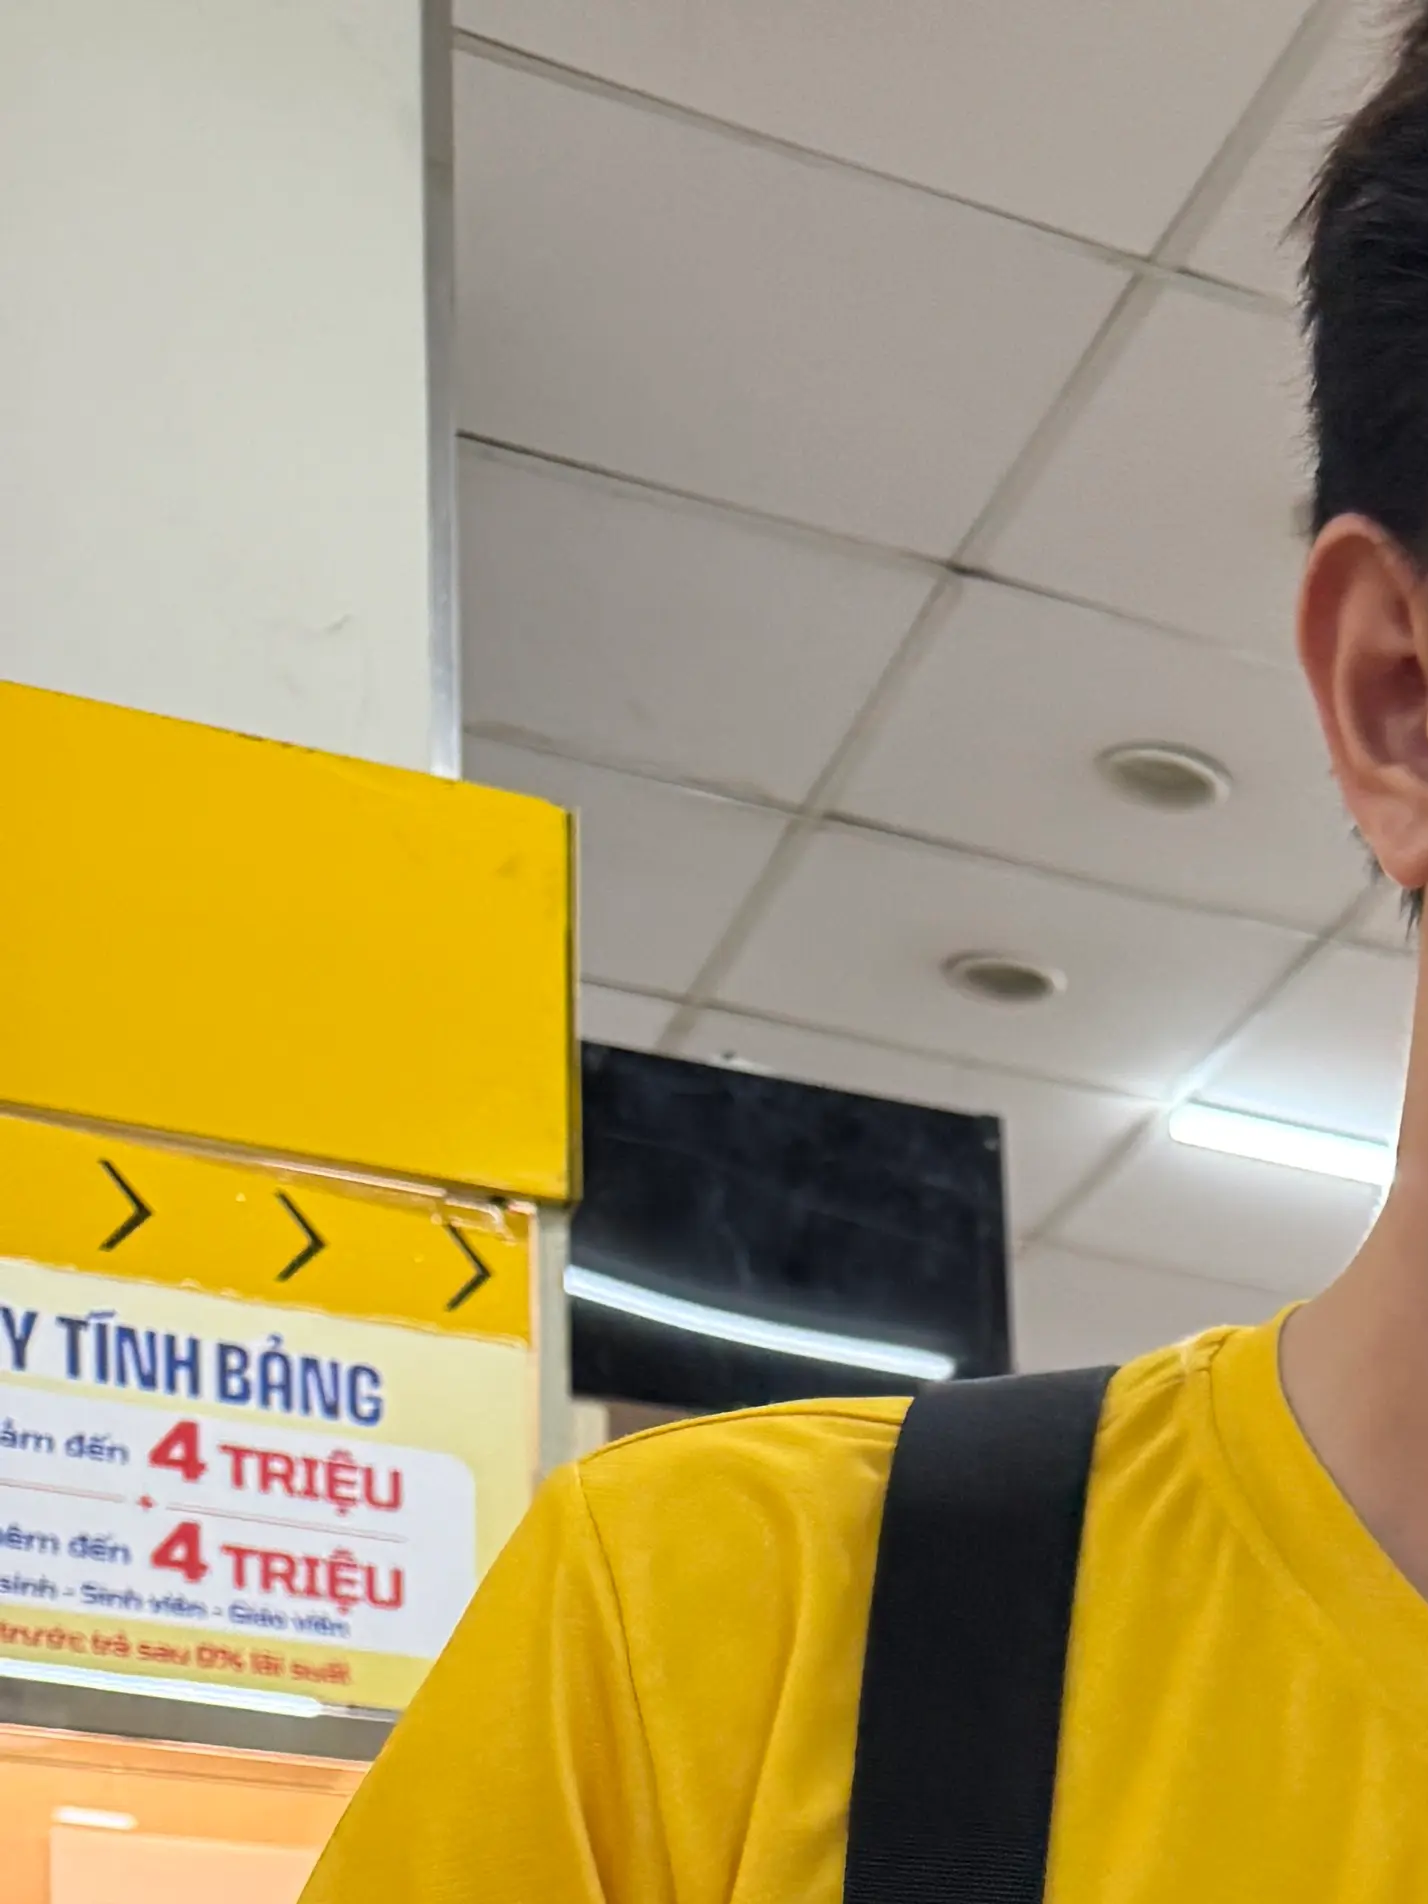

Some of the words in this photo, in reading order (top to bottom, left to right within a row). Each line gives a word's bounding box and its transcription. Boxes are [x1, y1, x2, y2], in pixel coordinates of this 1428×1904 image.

[56, 1310, 201, 1400] TÍNH
[216, 1333, 385, 1428] BẢNG
[148, 1419, 207, 1483] 4
[219, 1443, 404, 1516] TRIỆU
[151, 1522, 209, 1584] 4
[220, 1548, 405, 1616] TRIỆU
